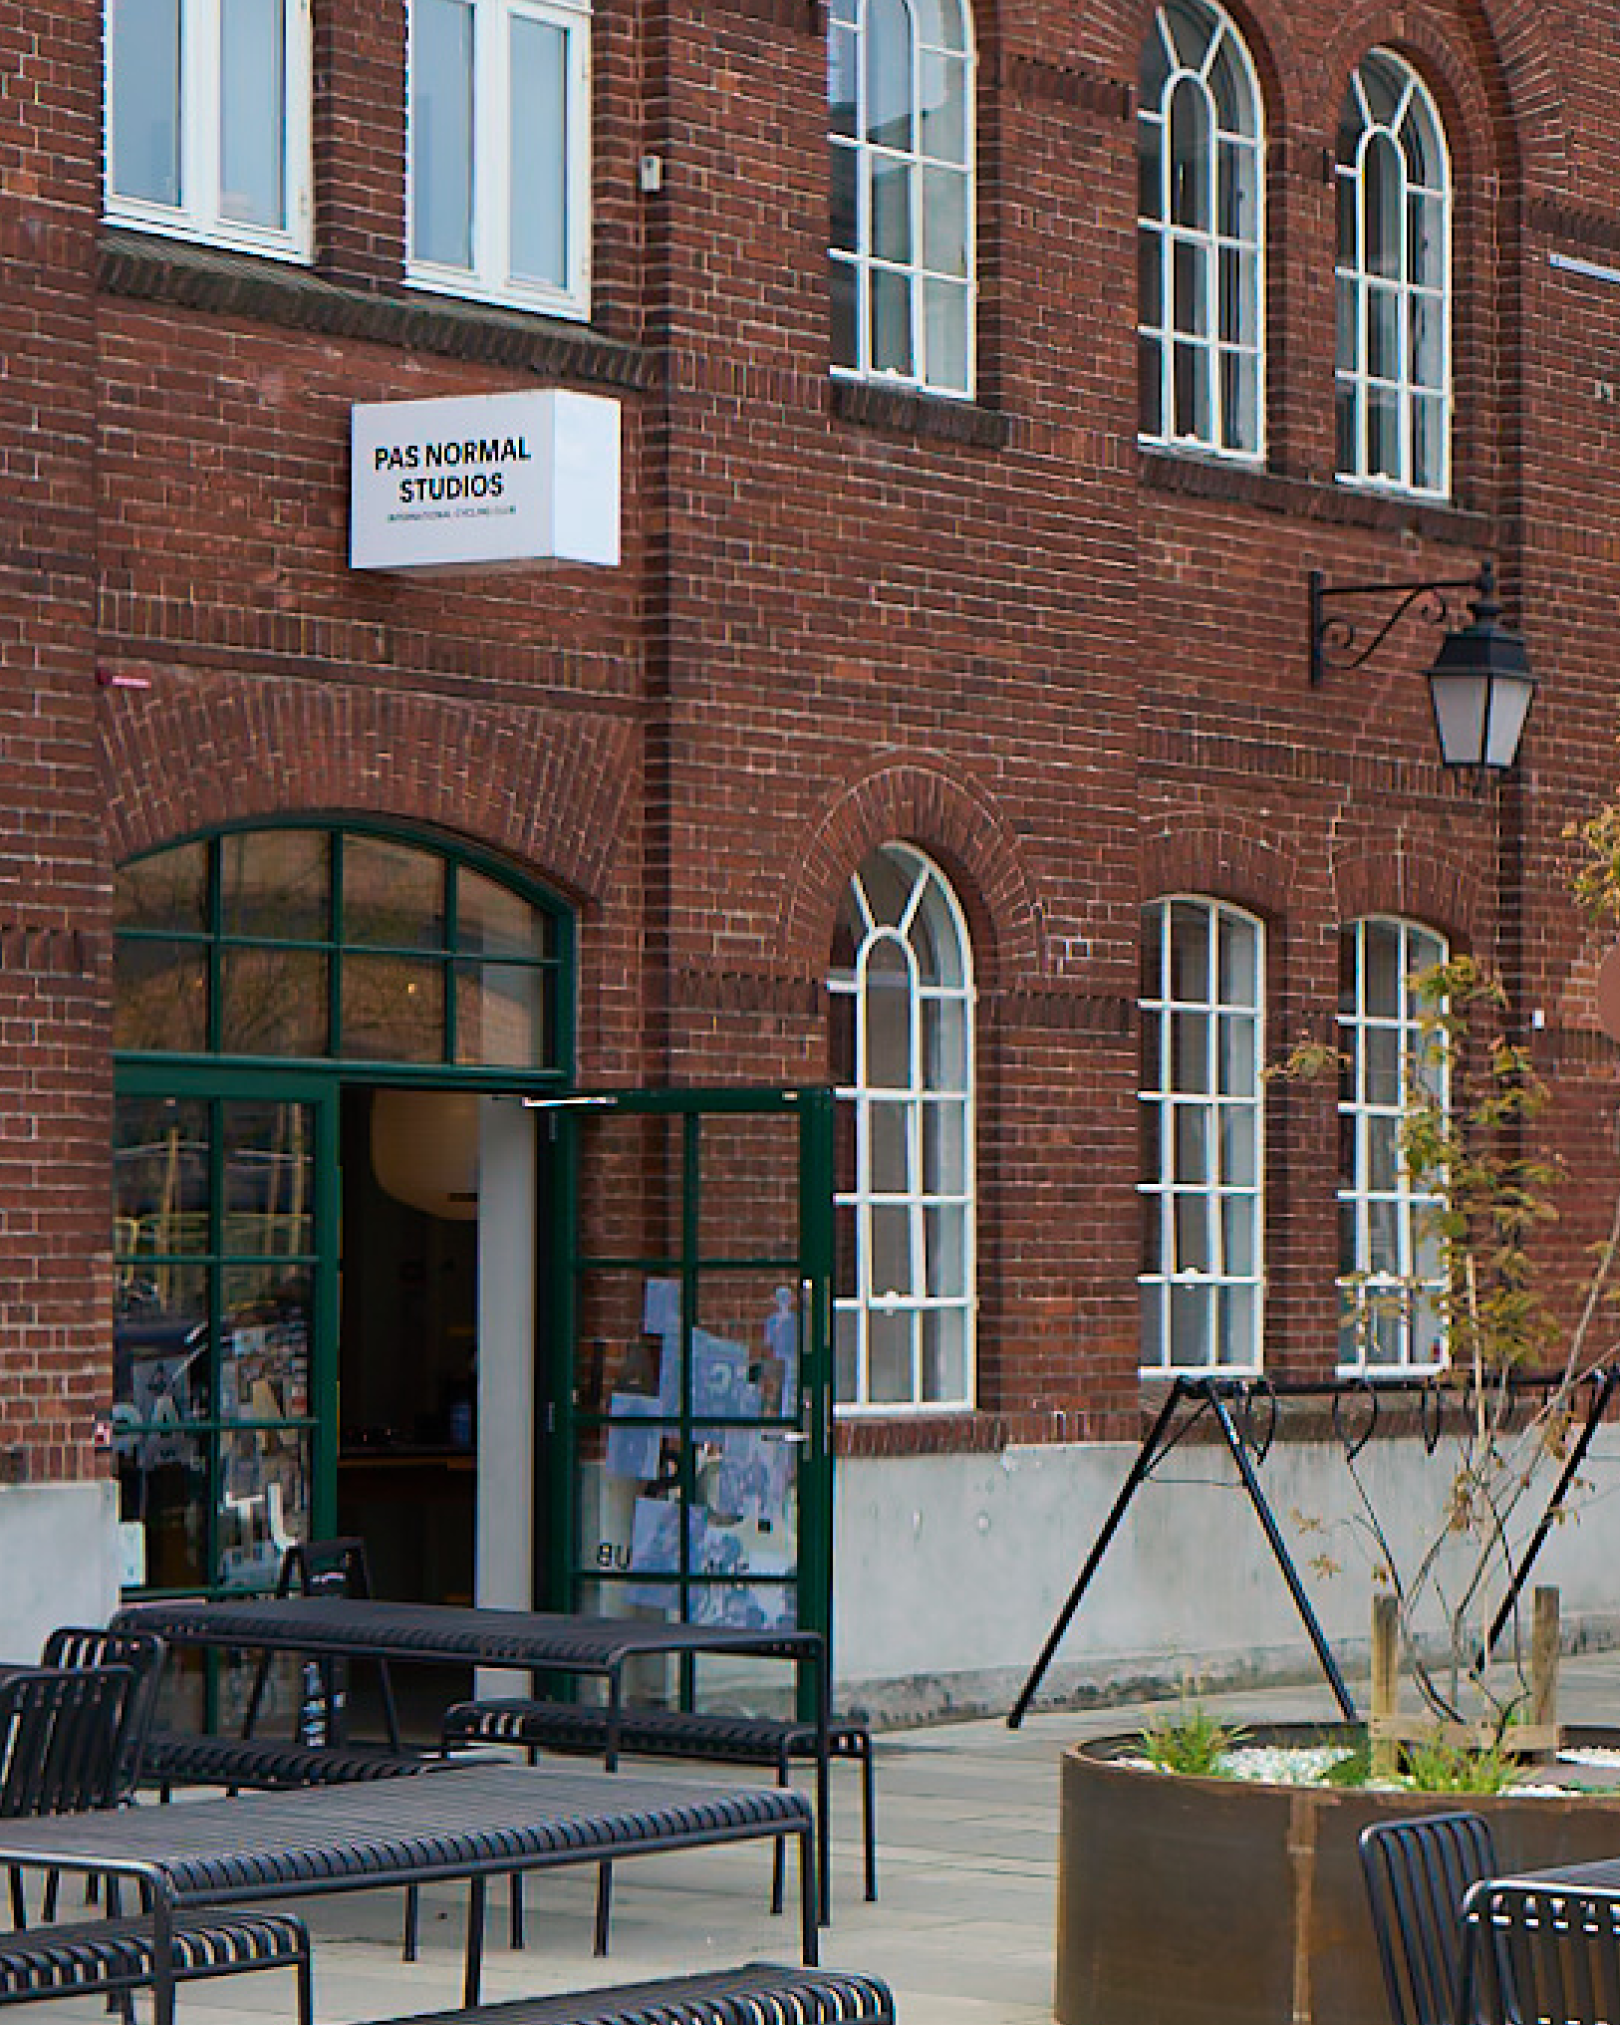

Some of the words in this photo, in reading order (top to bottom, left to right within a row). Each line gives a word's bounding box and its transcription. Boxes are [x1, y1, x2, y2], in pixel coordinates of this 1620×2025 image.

[374, 443, 420, 471] PAS
[426, 436, 532, 467] NORMAL
[399, 473, 504, 503] STUDIOS
